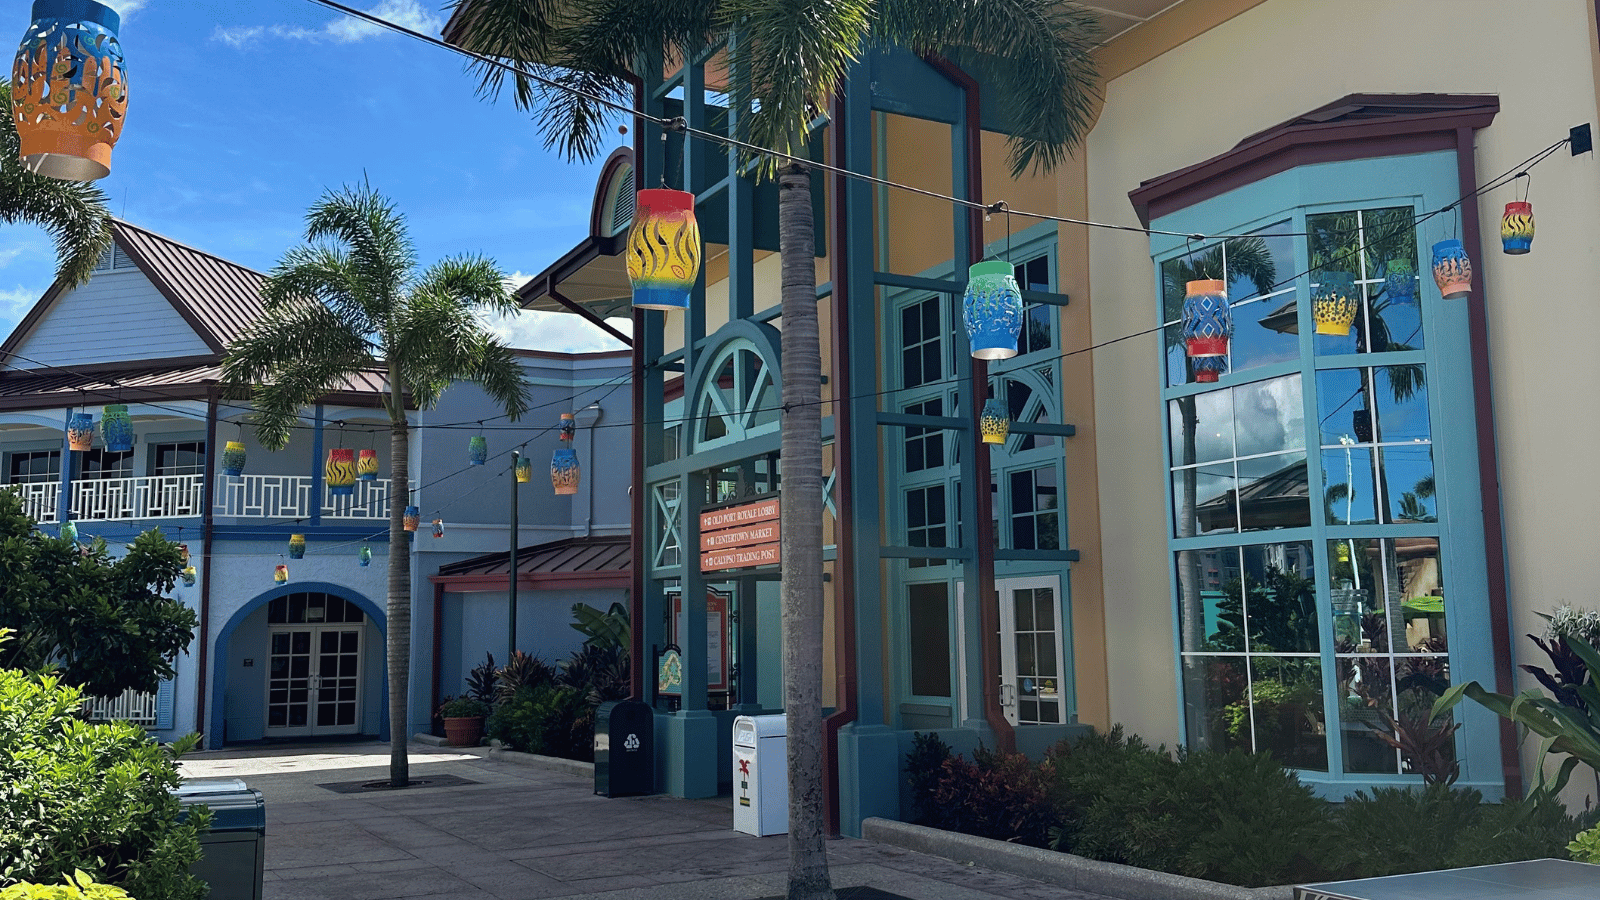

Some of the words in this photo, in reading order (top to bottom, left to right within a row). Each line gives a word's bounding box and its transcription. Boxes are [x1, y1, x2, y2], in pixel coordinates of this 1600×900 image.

[712, 515, 722, 525] OLD
[724, 512, 736, 523] PORT
[737, 508, 757, 520] ROYALE
[758, 505, 776, 517] LOBBY
[716, 532, 749, 545] CENTERTOWN
[750, 528, 773, 540] MARKET
[714, 554, 736, 566] CALYPSO
[736, 550, 760, 563] TRADING
[760, 549, 775, 560] POST
